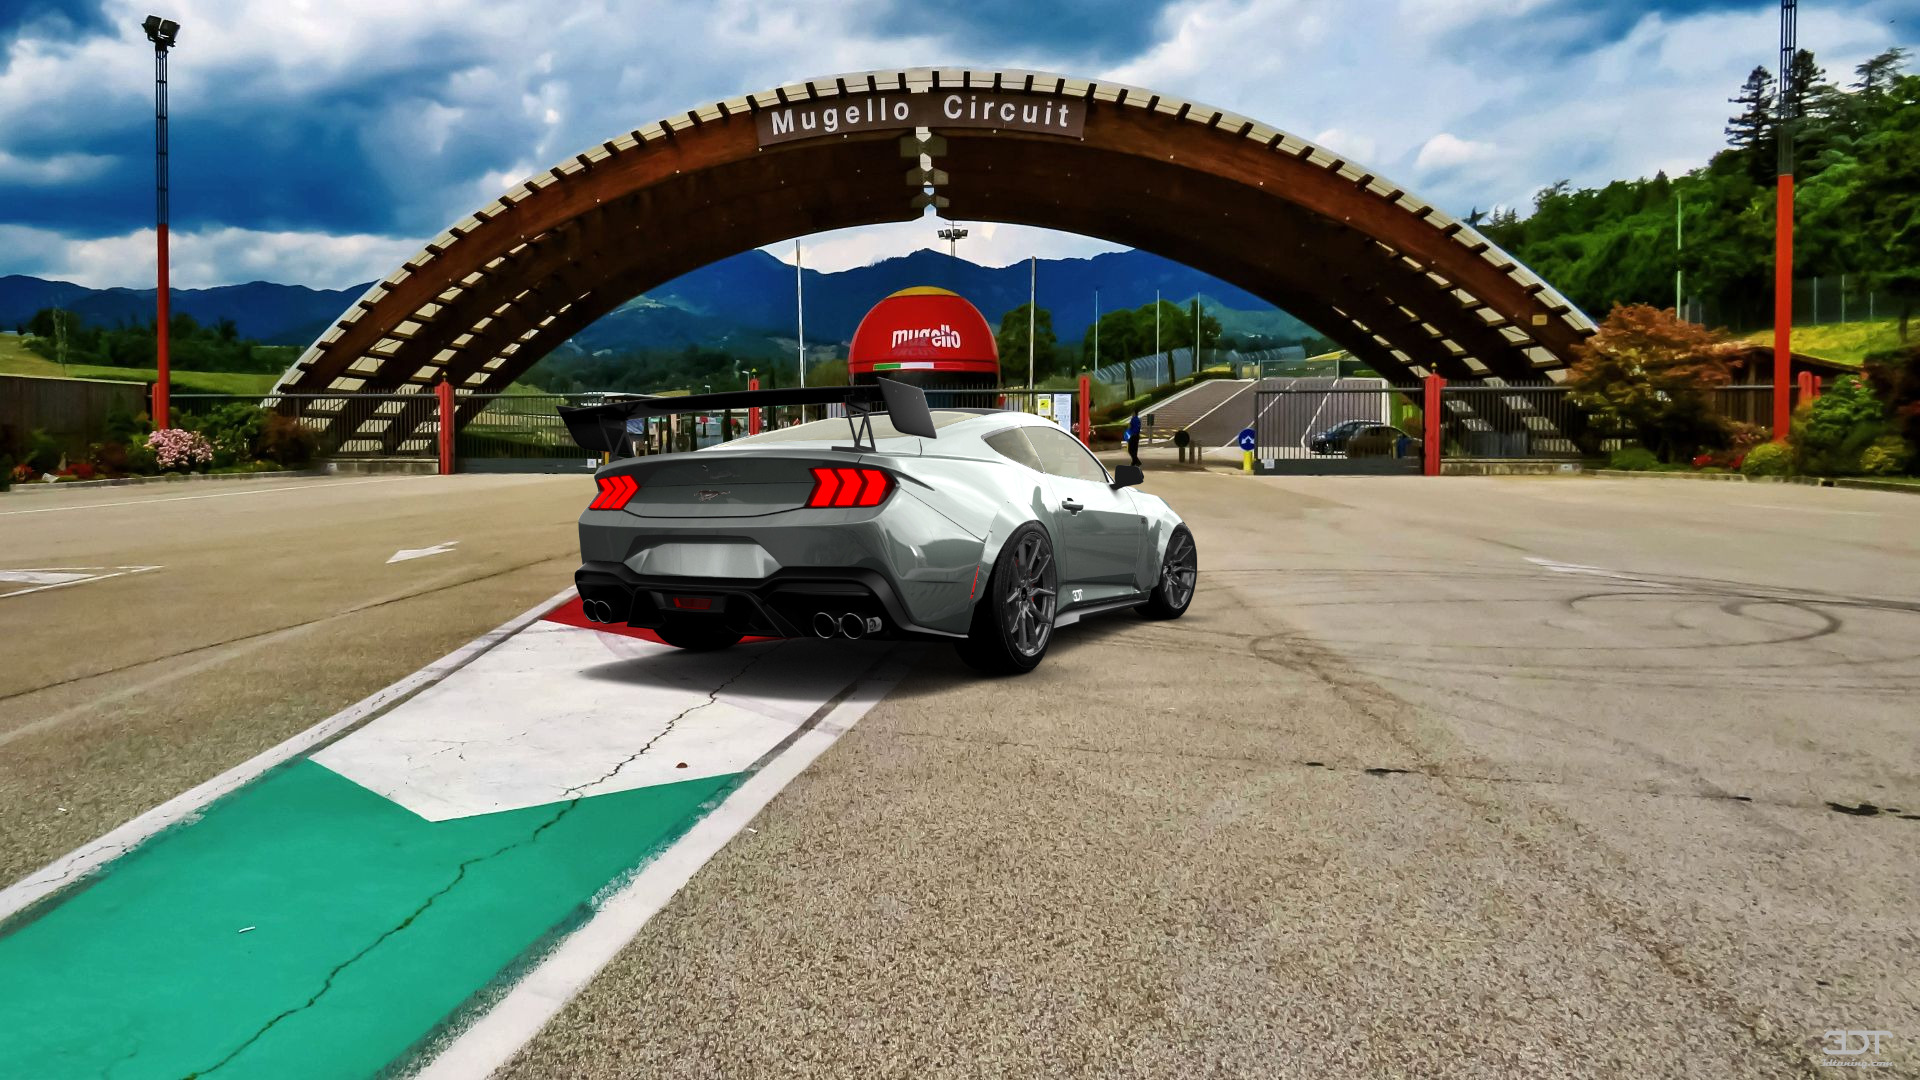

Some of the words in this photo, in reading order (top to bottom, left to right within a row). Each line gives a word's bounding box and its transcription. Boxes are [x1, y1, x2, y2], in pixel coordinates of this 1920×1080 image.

[771, 97, 909, 135] Mugello
[943, 95, 1069, 128] Circuit
[891, 323, 962, 349] mugello
